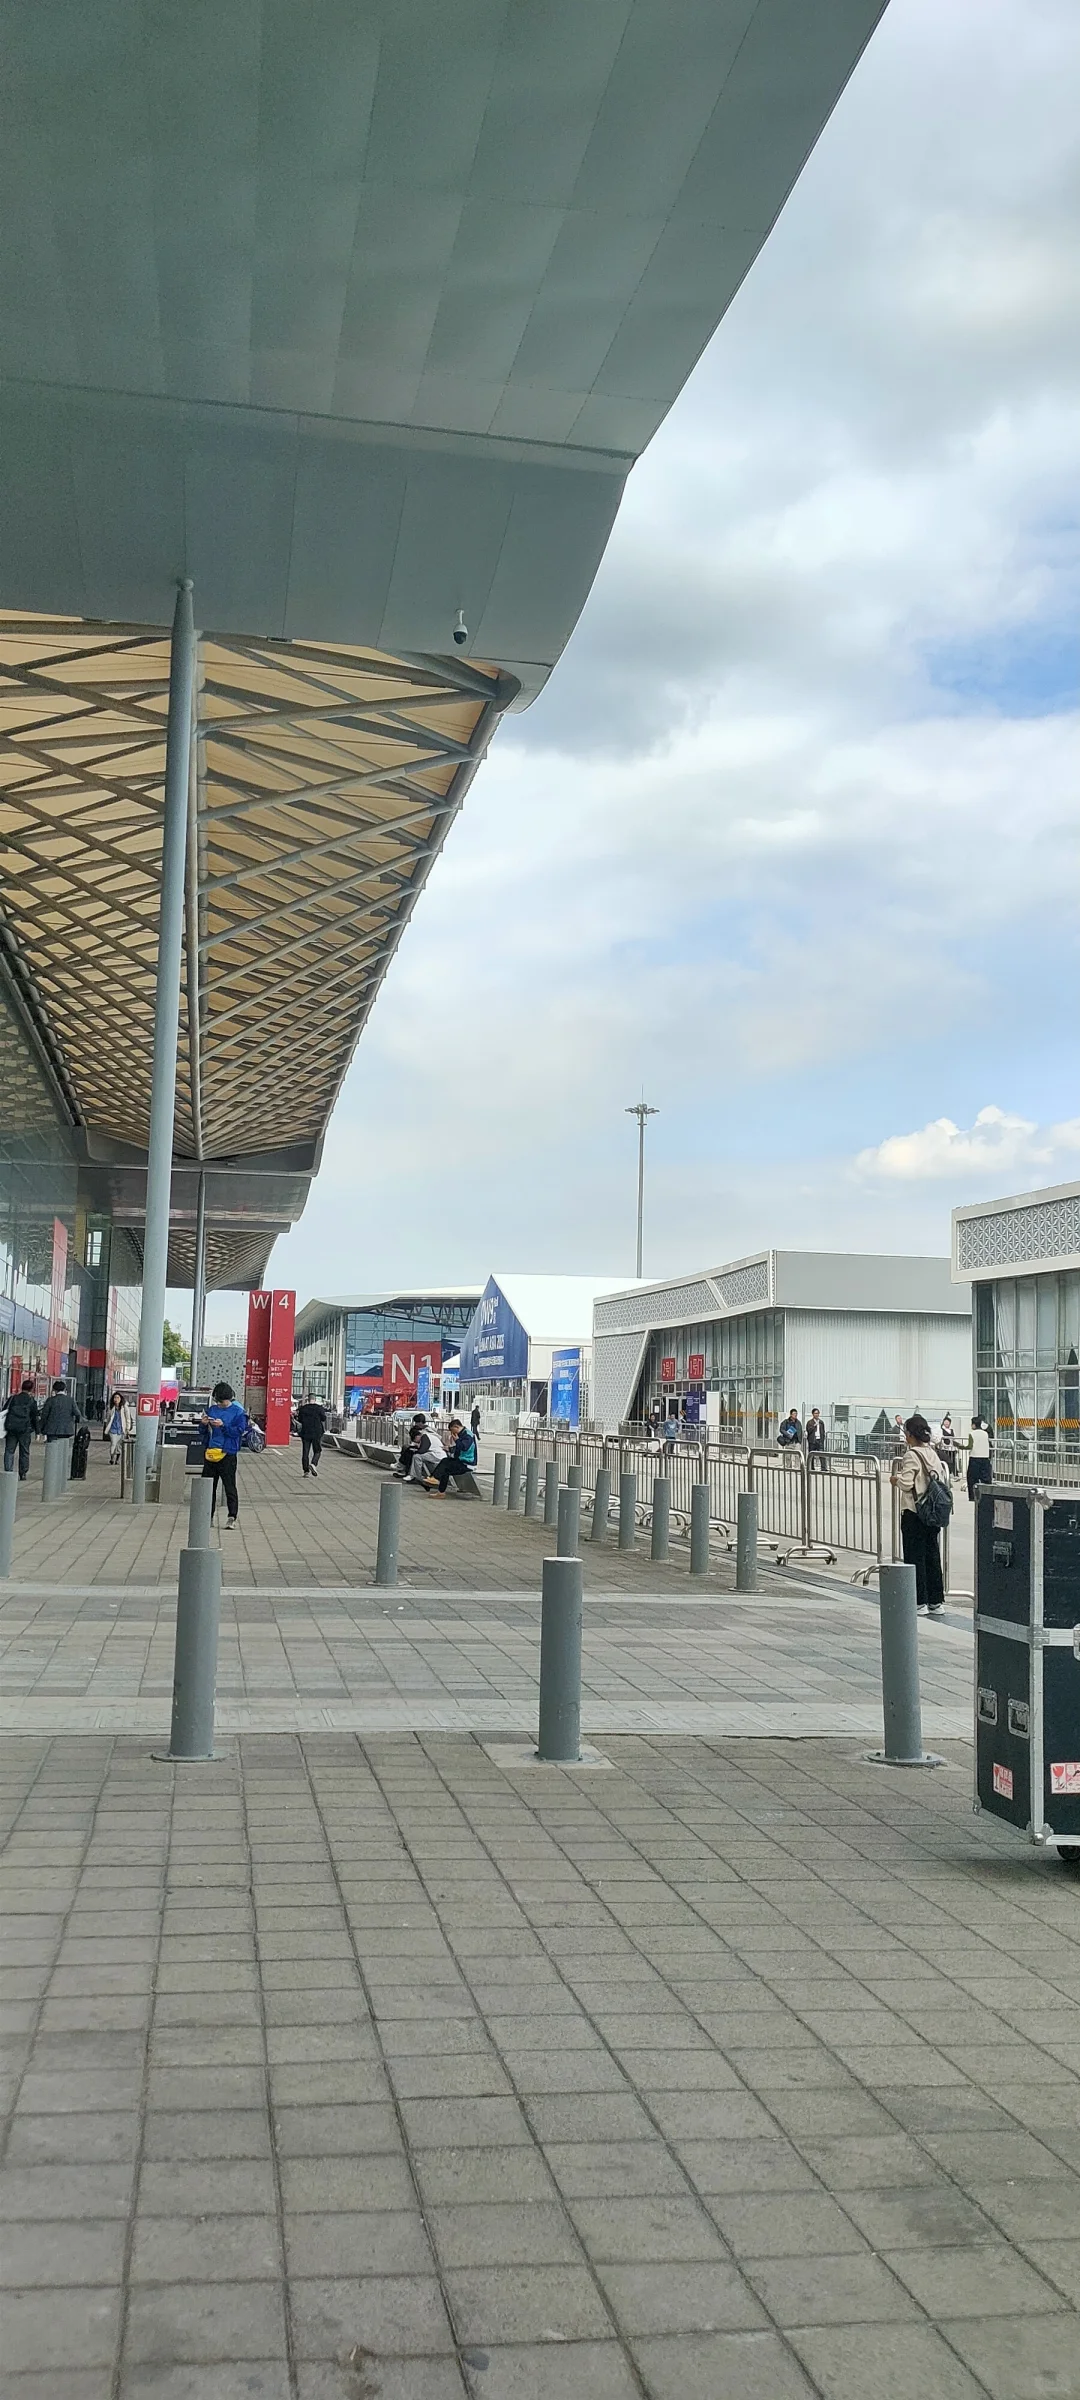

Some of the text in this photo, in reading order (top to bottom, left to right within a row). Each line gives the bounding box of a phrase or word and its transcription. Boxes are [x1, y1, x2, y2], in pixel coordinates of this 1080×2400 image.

[252, 1294, 289, 1309] W 4
[690, 1359, 703, 1375] 1号门
